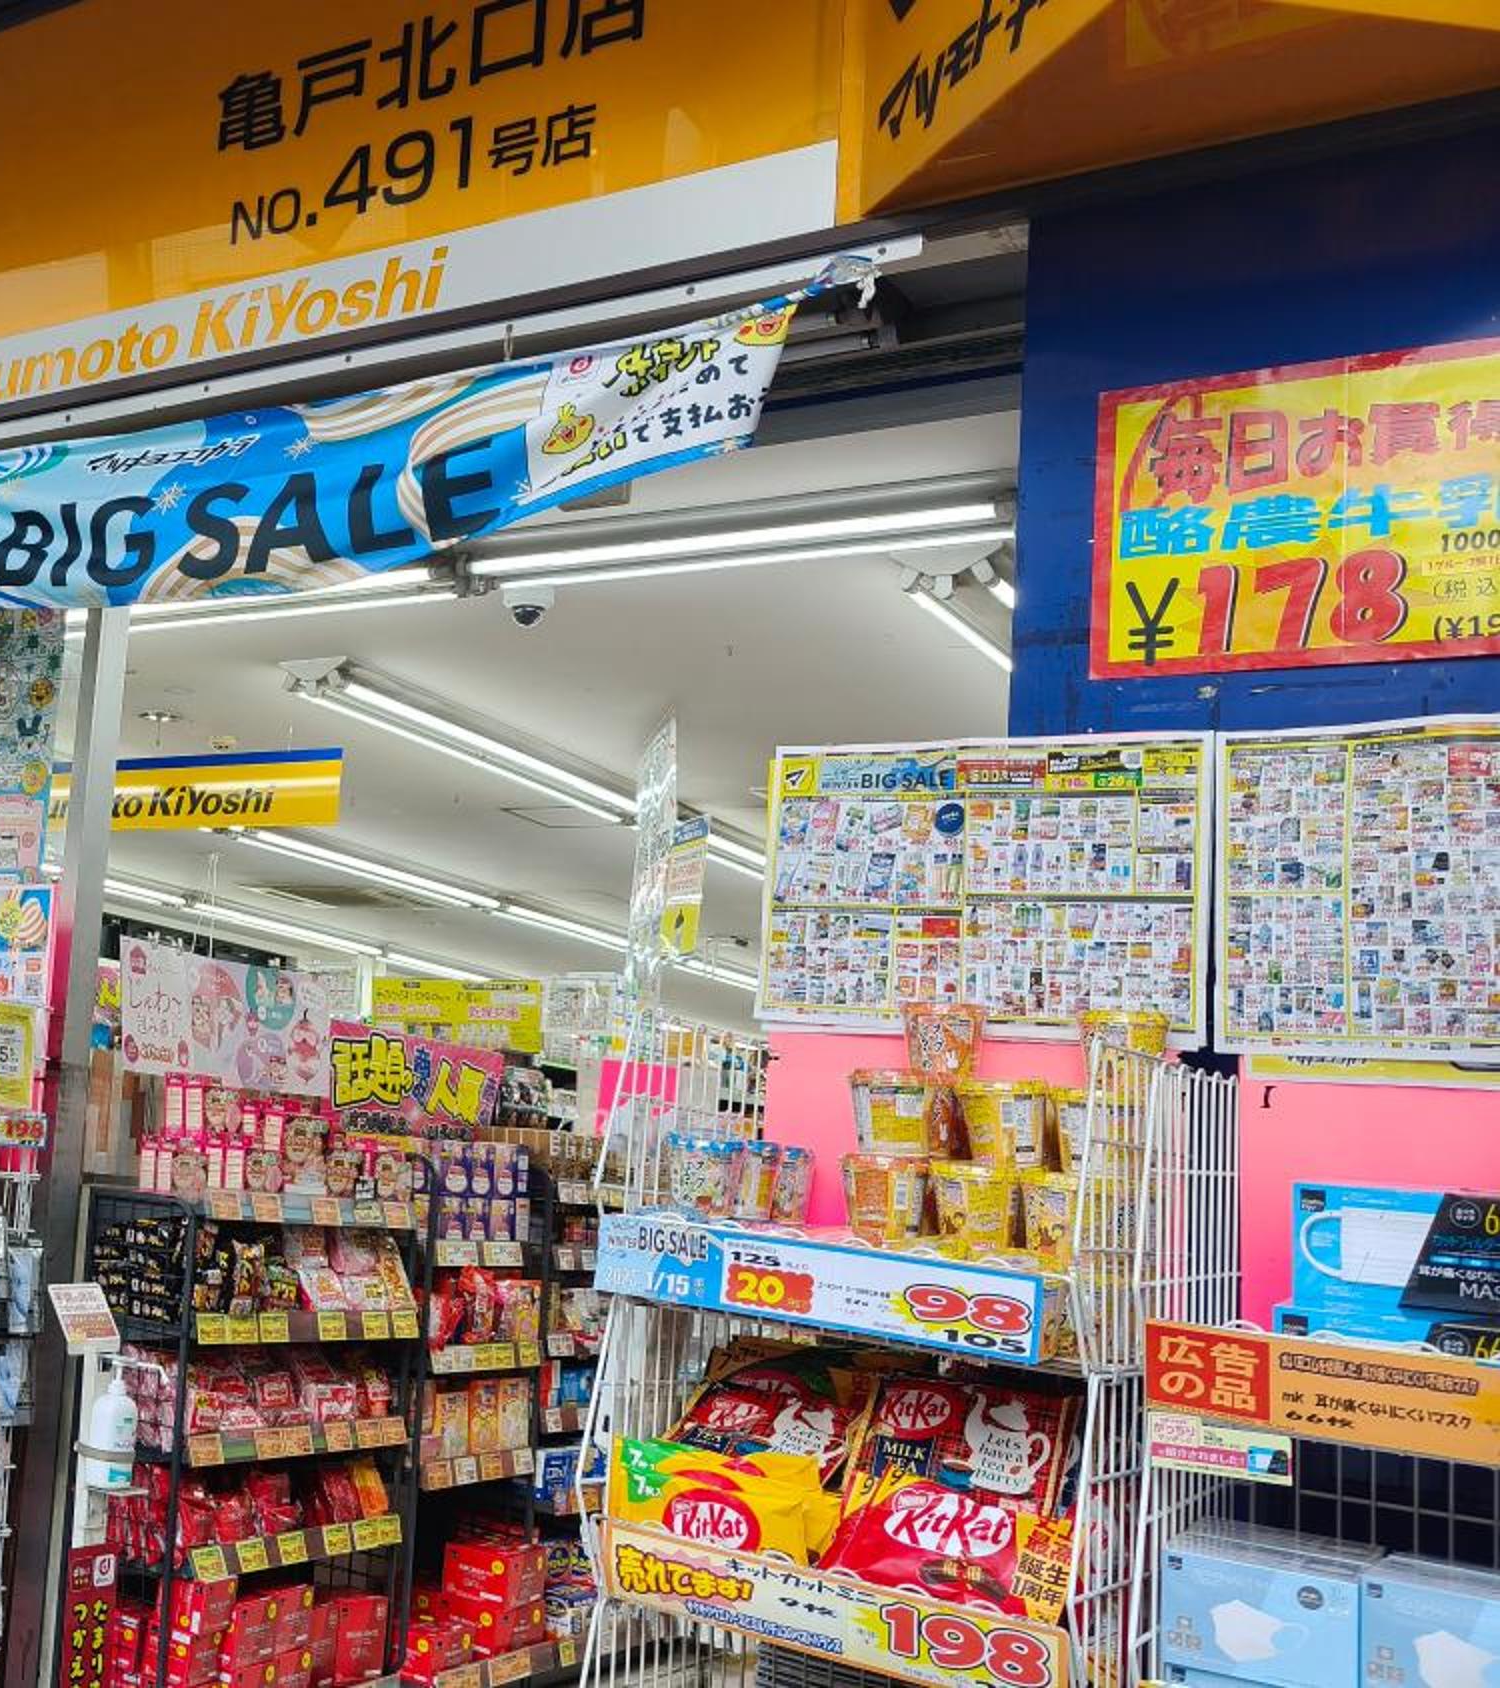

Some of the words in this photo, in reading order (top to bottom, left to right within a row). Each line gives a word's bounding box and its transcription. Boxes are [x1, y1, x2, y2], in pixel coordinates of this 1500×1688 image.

[217, 0, 645, 153] 亀戸北口店
[631, 386, 768, 443] で支払お
[179, 439, 500, 580] SALE
[639, 1226, 665, 1251] BIG
[668, 1231, 707, 1261] SALE
[730, 1250, 781, 1267] 125
[736, 1270, 785, 1306] 20
[903, 1283, 1032, 1336] 98
[943, 1328, 1027, 1355] 105
[1157, 1334, 1259, 1378] 広告
[882, 1390, 947, 1429] KitKat
[1158, 1370, 1258, 1411] の品
[883, 1440, 926, 1460] MILK
[979, 1444, 1010, 1463] have
[982, 1457, 1006, 1473] tea
[680, 1501, 744, 1540] KitKat
[892, 1493, 1010, 1558] KitKat
[615, 1543, 755, 1602] 売れてます!
[1017, 1552, 1071, 1590] 誕生
[881, 1601, 1051, 1688] 198
